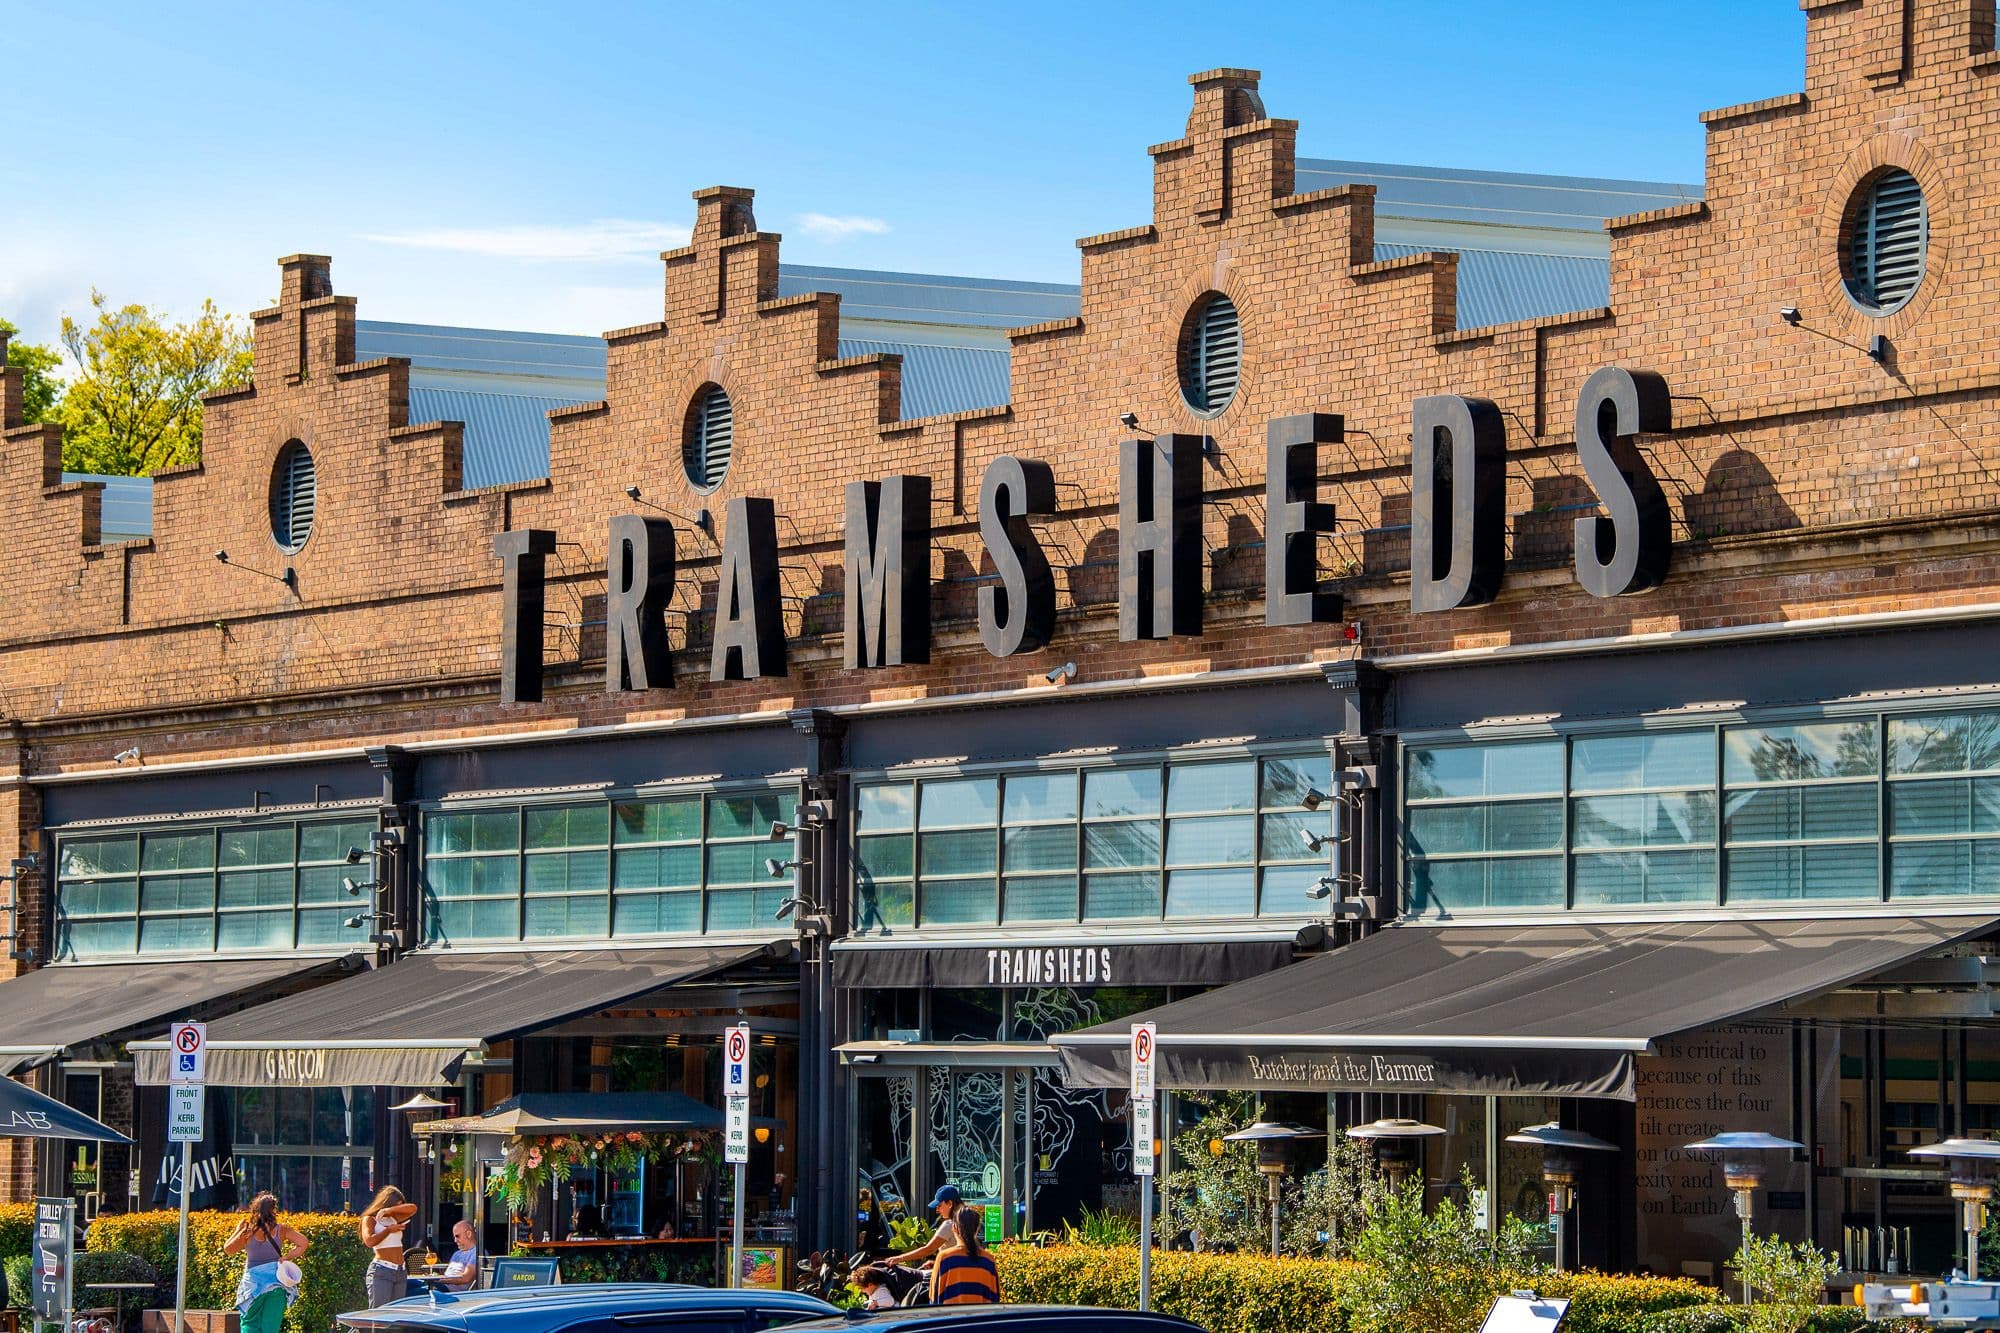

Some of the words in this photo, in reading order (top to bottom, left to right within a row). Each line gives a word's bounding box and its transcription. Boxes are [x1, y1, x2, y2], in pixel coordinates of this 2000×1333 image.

[494, 367, 1672, 704] TRAMSHEDS
[987, 947, 1112, 983] TRAMSHEDS
[1671, 1039, 1682, 1058] is
[1687, 1040, 1744, 1060] critical
[1750, 1044, 1766, 1061] to
[265, 1048, 326, 1086] GARÇON
[1636, 1065, 1702, 1085] because
[1707, 1066, 1726, 1085] of
[1732, 1067, 1761, 1086] this
[176, 1089, 199, 1098] FRONT
[182, 1101, 192, 1110] TO
[730, 1102, 745, 1112] FRONT
[1706, 1092, 1733, 1111] the
[1738, 1092, 1773, 1112] four
[177, 1113, 195, 1123] KERB
[1137, 1108, 1150, 1118] FRONT
[734, 1116, 741, 1126] TO
[1640, 1116, 1662, 1136] tilt
[1667, 1121, 1725, 1137] creates
[171, 1126, 200, 1135] PARKING
[730, 1130, 742, 1140] KERB
[727, 1145, 746, 1155] PARKING
[1664, 1148, 1680, 1163] to
[1135, 1155, 1153, 1167] PARKING
[1681, 1170, 1713, 1189] and
[39, 1203, 63, 1220] TROLLEY
[1642, 1200, 1664, 1215] on
[39, 1222, 61, 1240] RETURN
